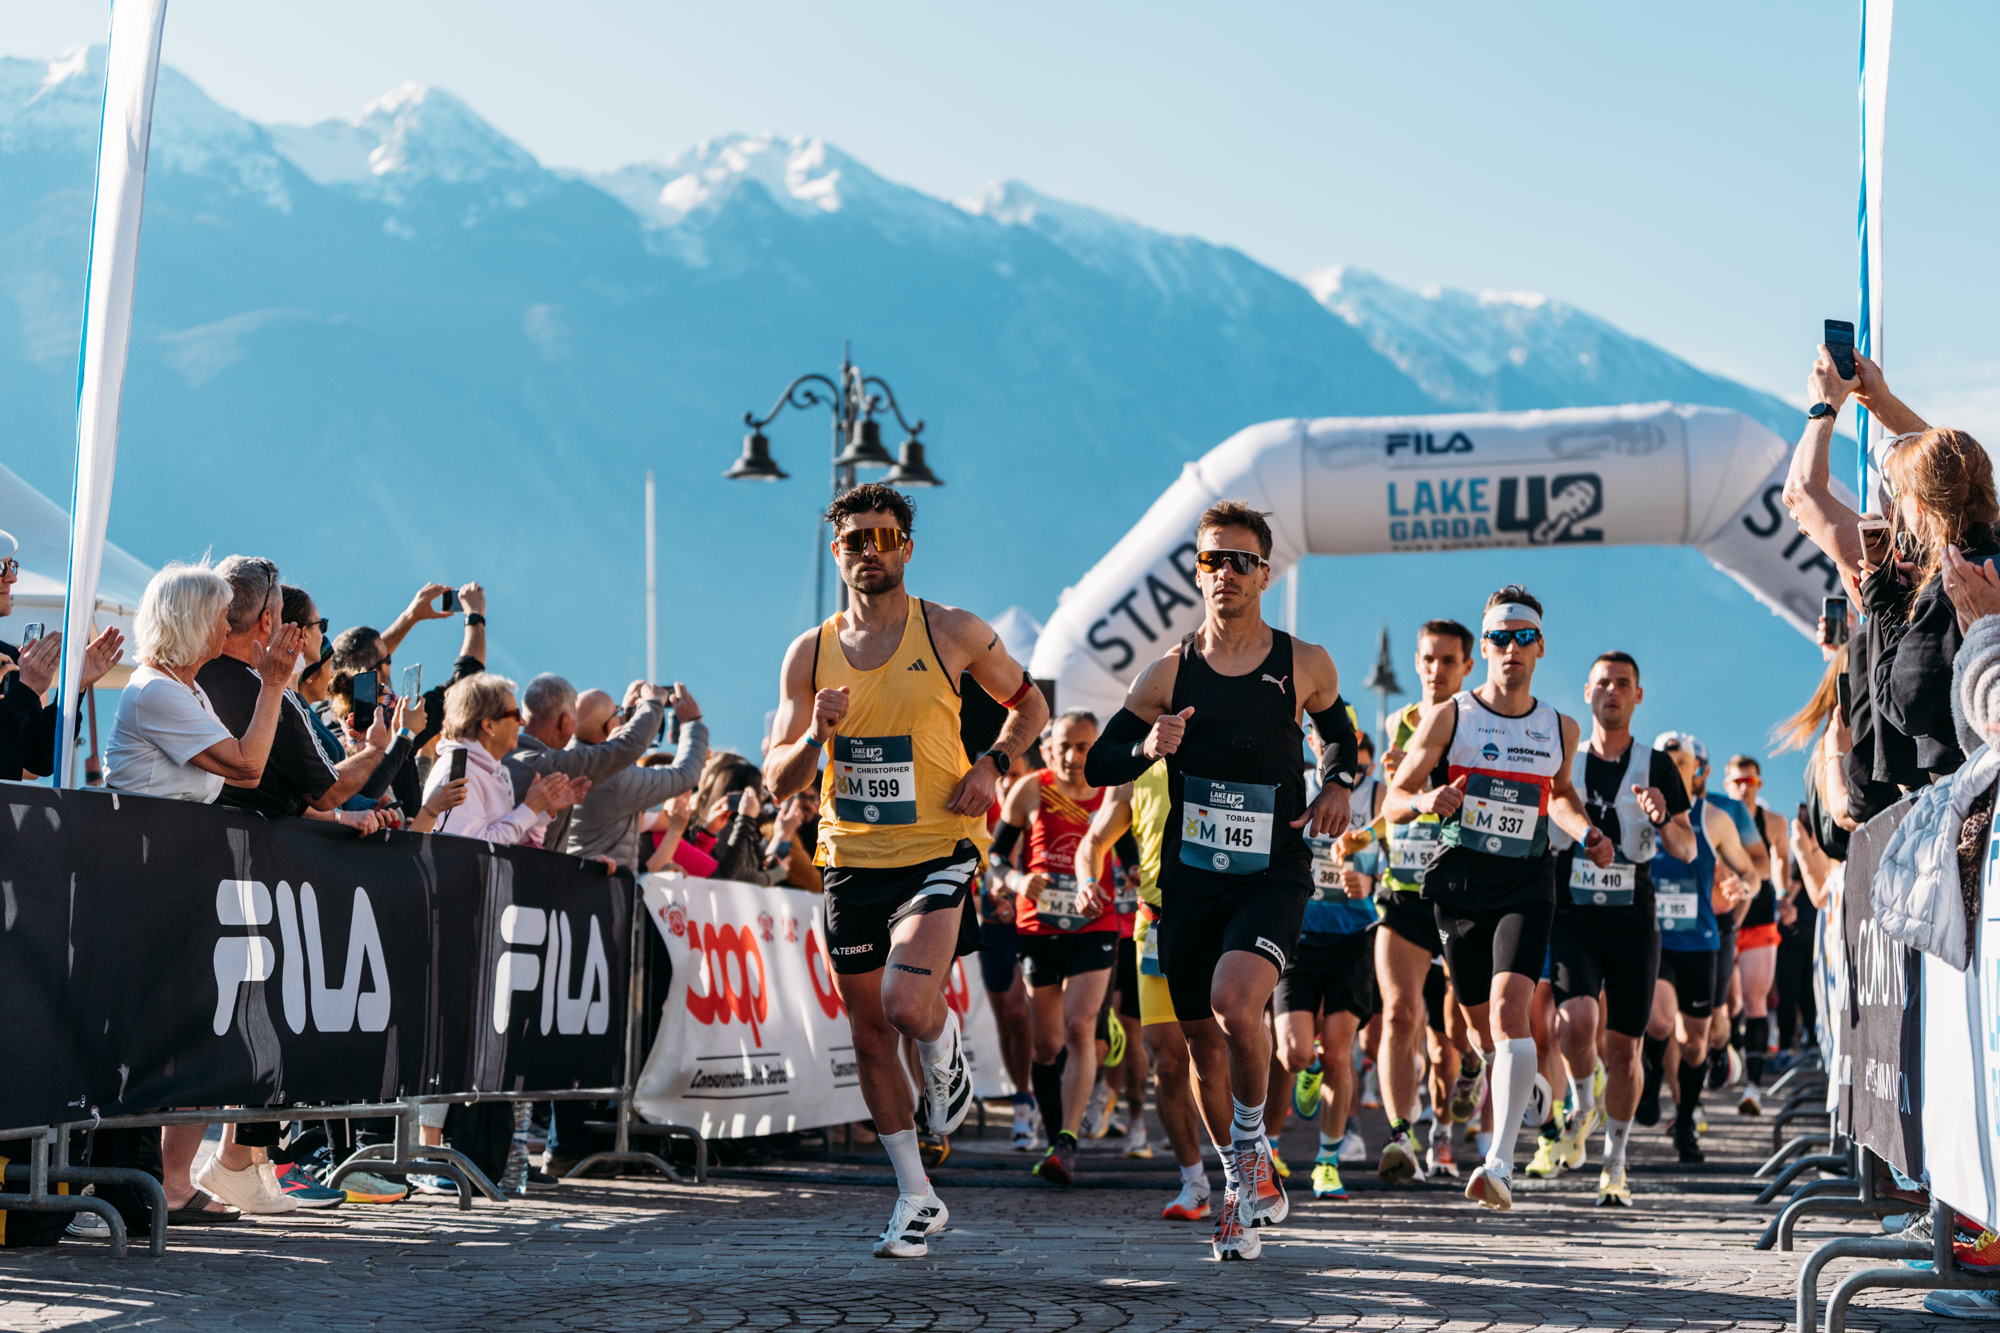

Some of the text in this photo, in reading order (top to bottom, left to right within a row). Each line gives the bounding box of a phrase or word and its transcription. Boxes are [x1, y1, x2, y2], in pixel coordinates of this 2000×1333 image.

[1386, 431, 1474, 456] FILA
[1388, 472, 1605, 544] LAKE 42
[1390, 517, 1491, 541] GARDA
[1087, 542, 1203, 672] STAR
[1507, 747, 1551, 758] HOSOKAWA
[857, 766, 909, 774] CHRISTOPHER
[848, 777, 899, 798] M 599
[1210, 791, 1226, 799] LAKE
[1227, 793, 1244, 809] 42
[1226, 814, 1256, 823] TOBIAS
[1502, 806, 1525, 814] SIMON
[1477, 811, 1524, 834] M 337
[1200, 821, 1253, 847] M 145
[1403, 852, 1415, 864] M
[1320, 871, 1340, 884] 387
[1582, 872, 1622, 887] M 410
[1050, 901, 1062, 912] M
[213, 879, 391, 1036] FILA
[839, 943, 874, 956] TERREX
[493, 904, 610, 1036] FILA
[1857, 917, 1909, 1011] COMUN
